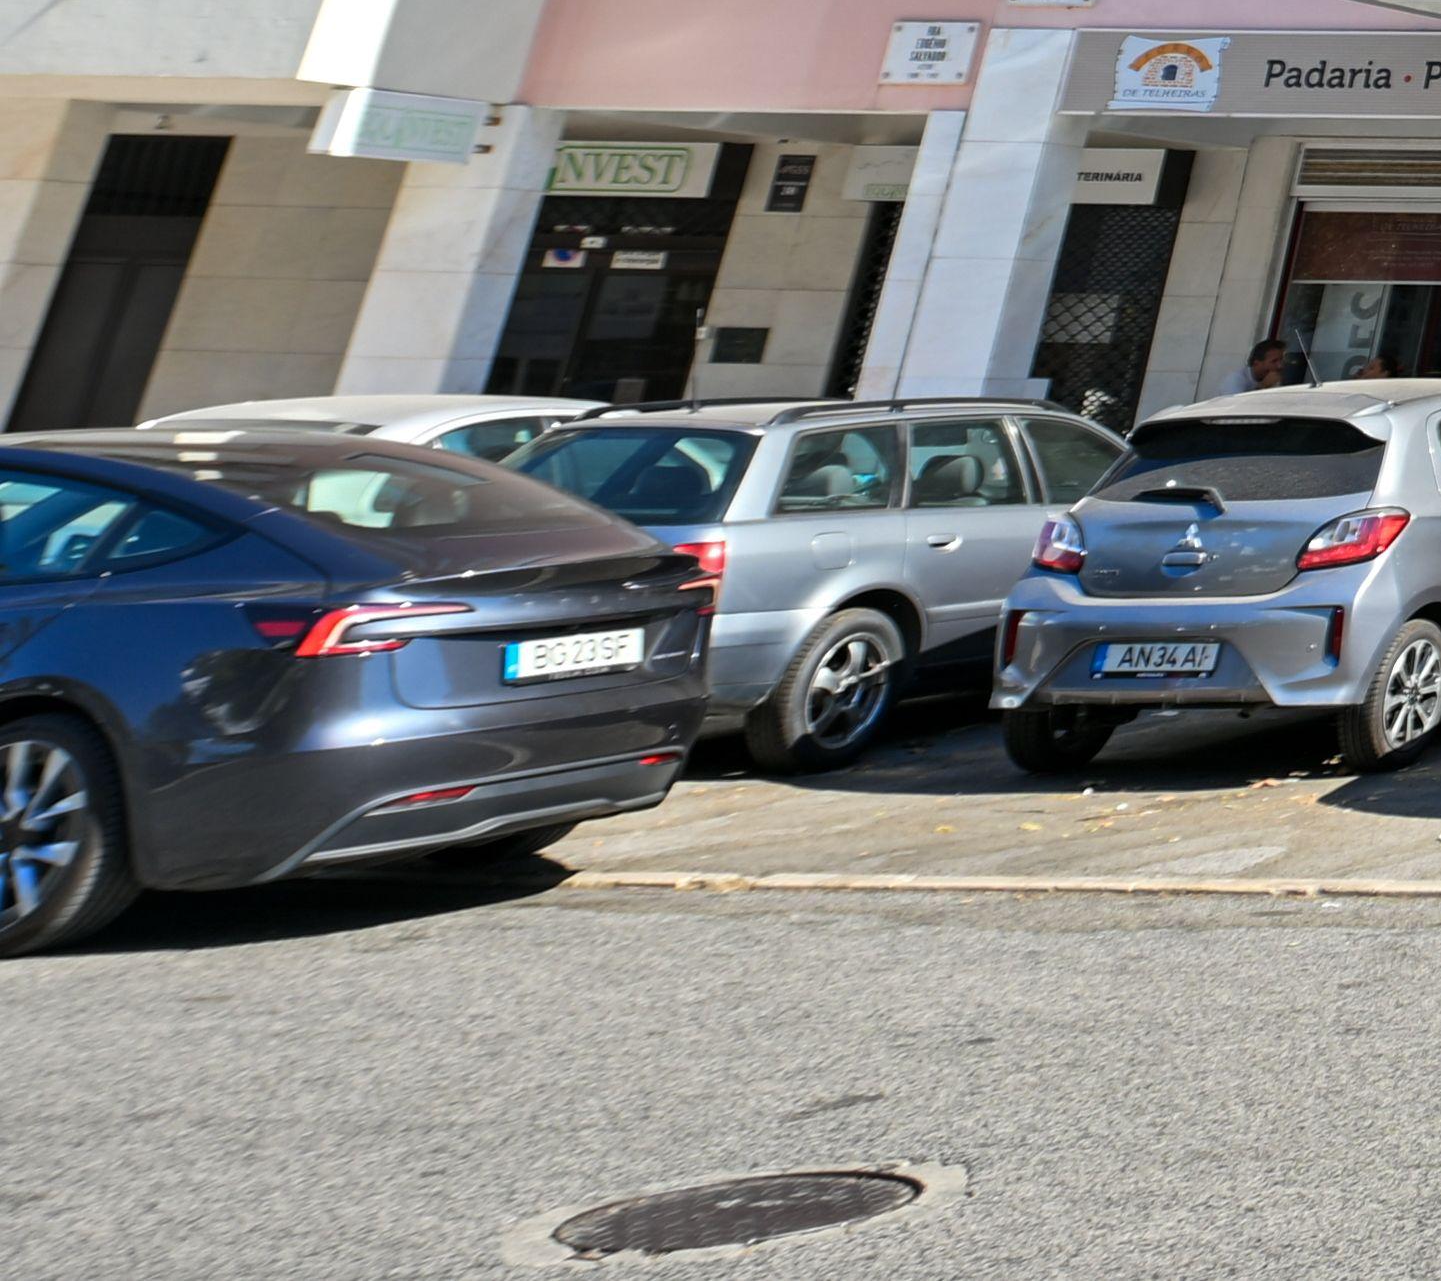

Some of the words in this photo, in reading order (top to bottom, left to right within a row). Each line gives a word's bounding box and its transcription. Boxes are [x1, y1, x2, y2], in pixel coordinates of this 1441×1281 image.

[1264, 60, 1392, 90] Padaria
[1142, 89, 1206, 98] TELHEIRAS
[1077, 170, 1143, 182] TERINÁRIA
